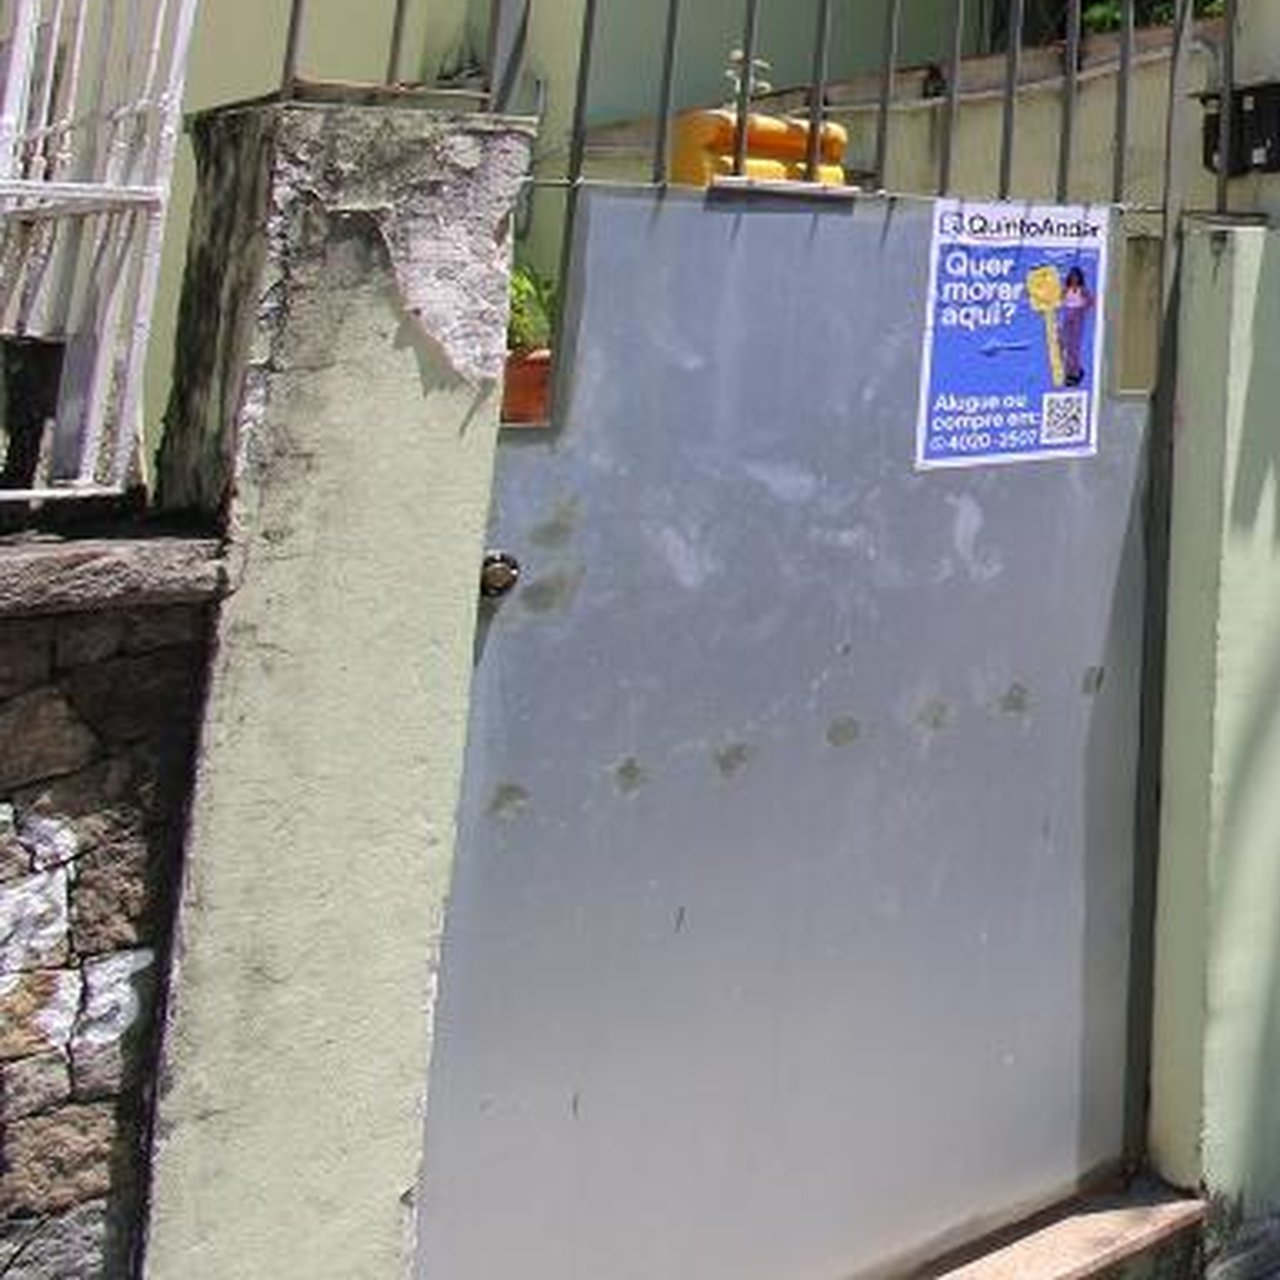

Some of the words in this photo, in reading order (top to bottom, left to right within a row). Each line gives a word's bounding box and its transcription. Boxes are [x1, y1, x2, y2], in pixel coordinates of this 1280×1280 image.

[946, 251, 1014, 278] Quer
[942, 280, 1024, 302] morar
[942, 301, 1017, 331] aqui?
